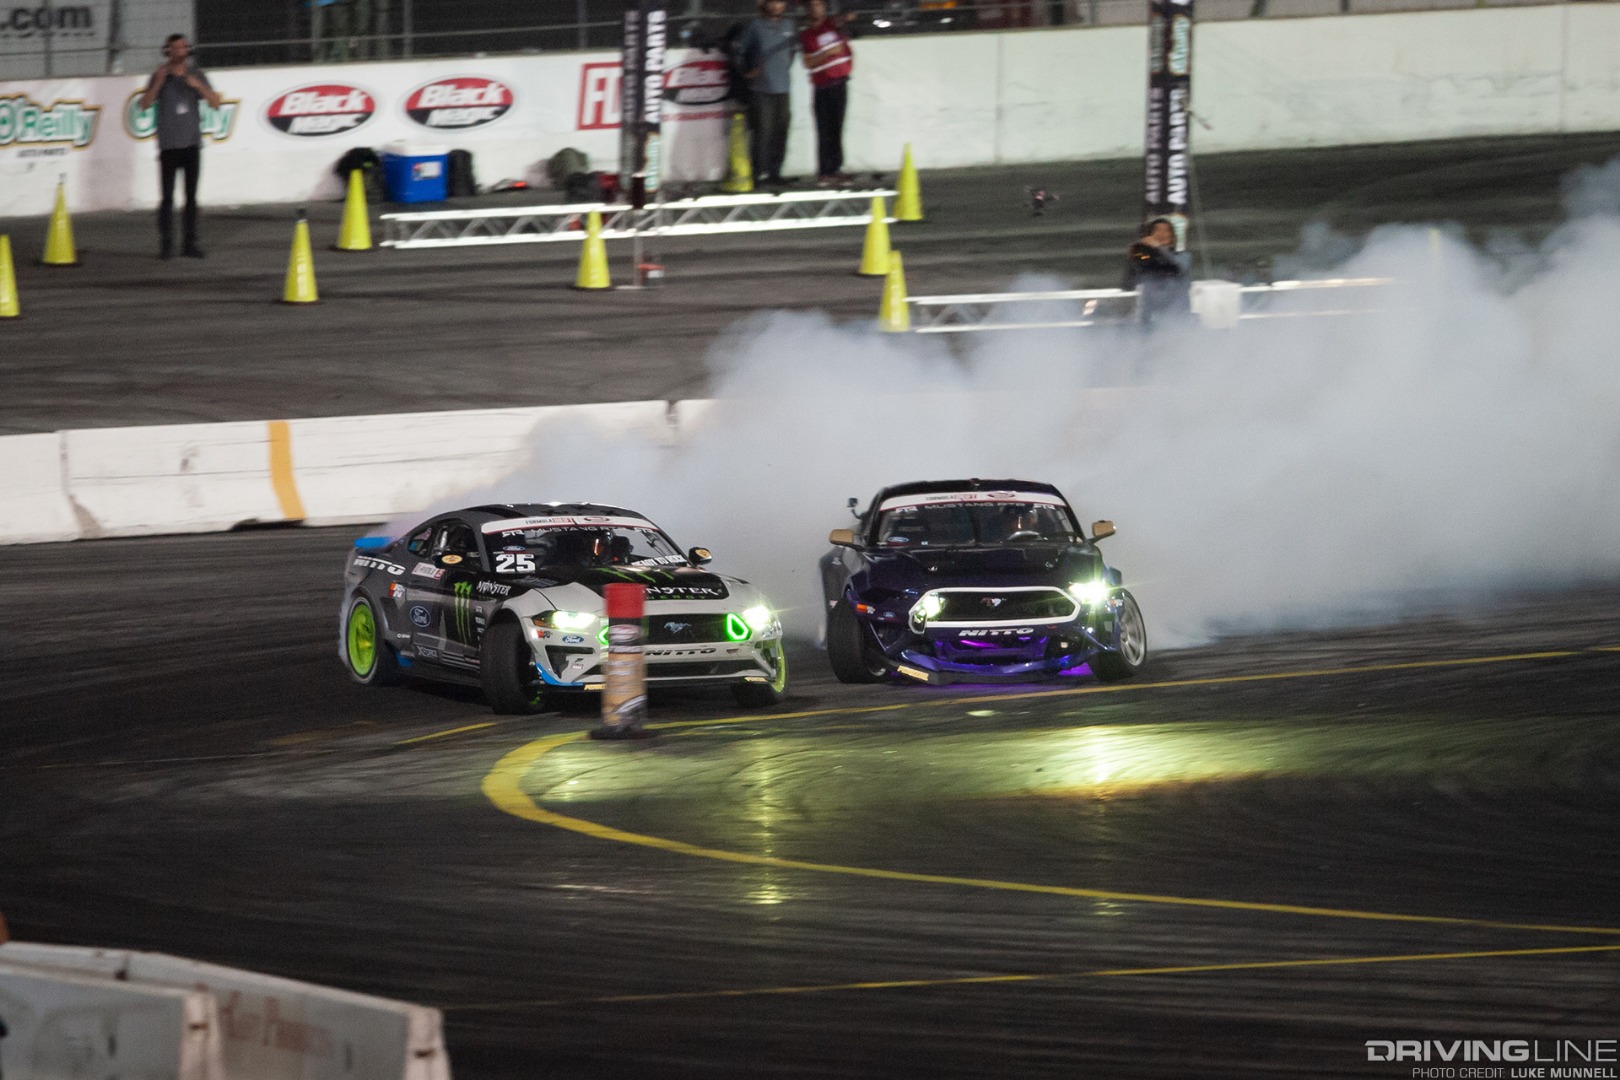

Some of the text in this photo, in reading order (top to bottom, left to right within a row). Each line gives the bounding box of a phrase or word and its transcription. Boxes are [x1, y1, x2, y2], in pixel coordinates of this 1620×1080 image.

[279, 89, 367, 115] Black
[416, 82, 505, 107] Black
[496, 554, 536, 573] 25
[646, 585, 720, 596] NSTER
[958, 627, 1035, 637] NITTO
[644, 647, 717, 656] NITTO
